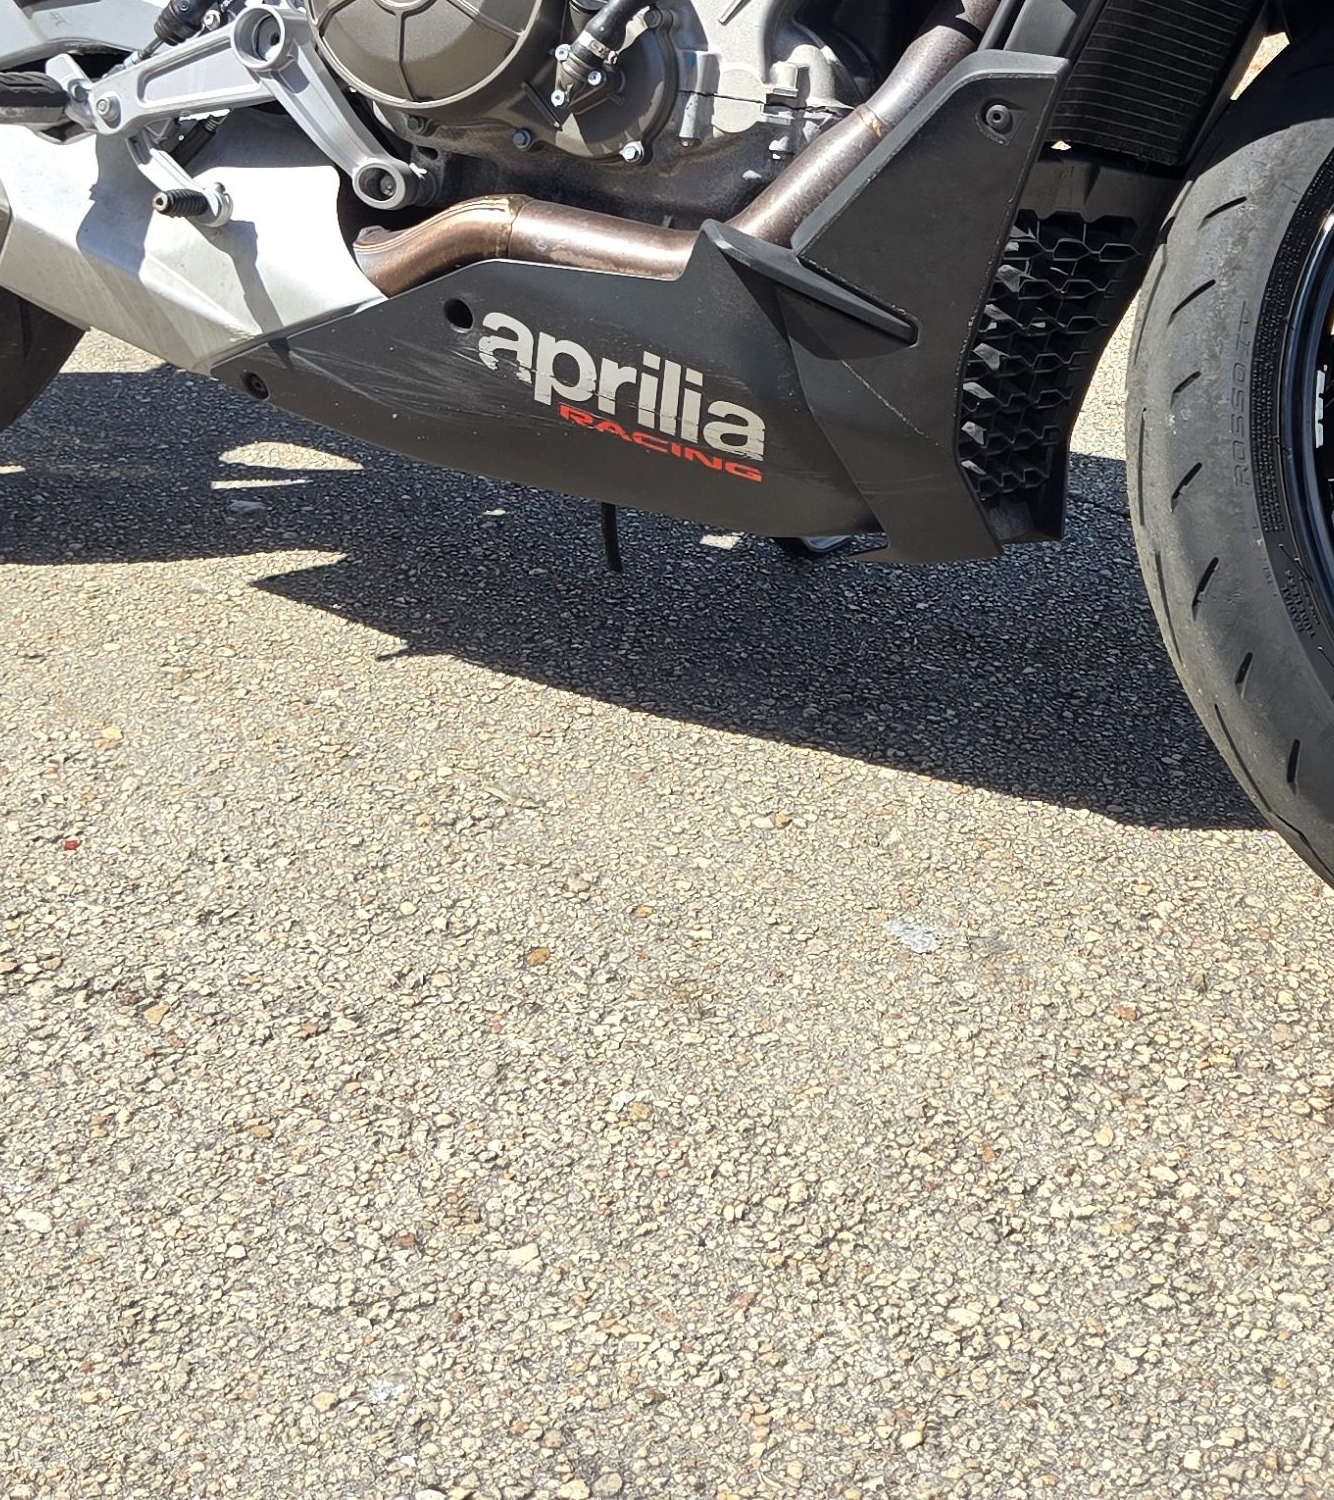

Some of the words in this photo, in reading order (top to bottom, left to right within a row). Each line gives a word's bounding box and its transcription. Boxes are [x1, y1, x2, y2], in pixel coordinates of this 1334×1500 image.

[478, 312, 765, 462] aprilia
[558, 402, 763, 483] RACING
[1230, 361, 1251, 489] ROSSO
